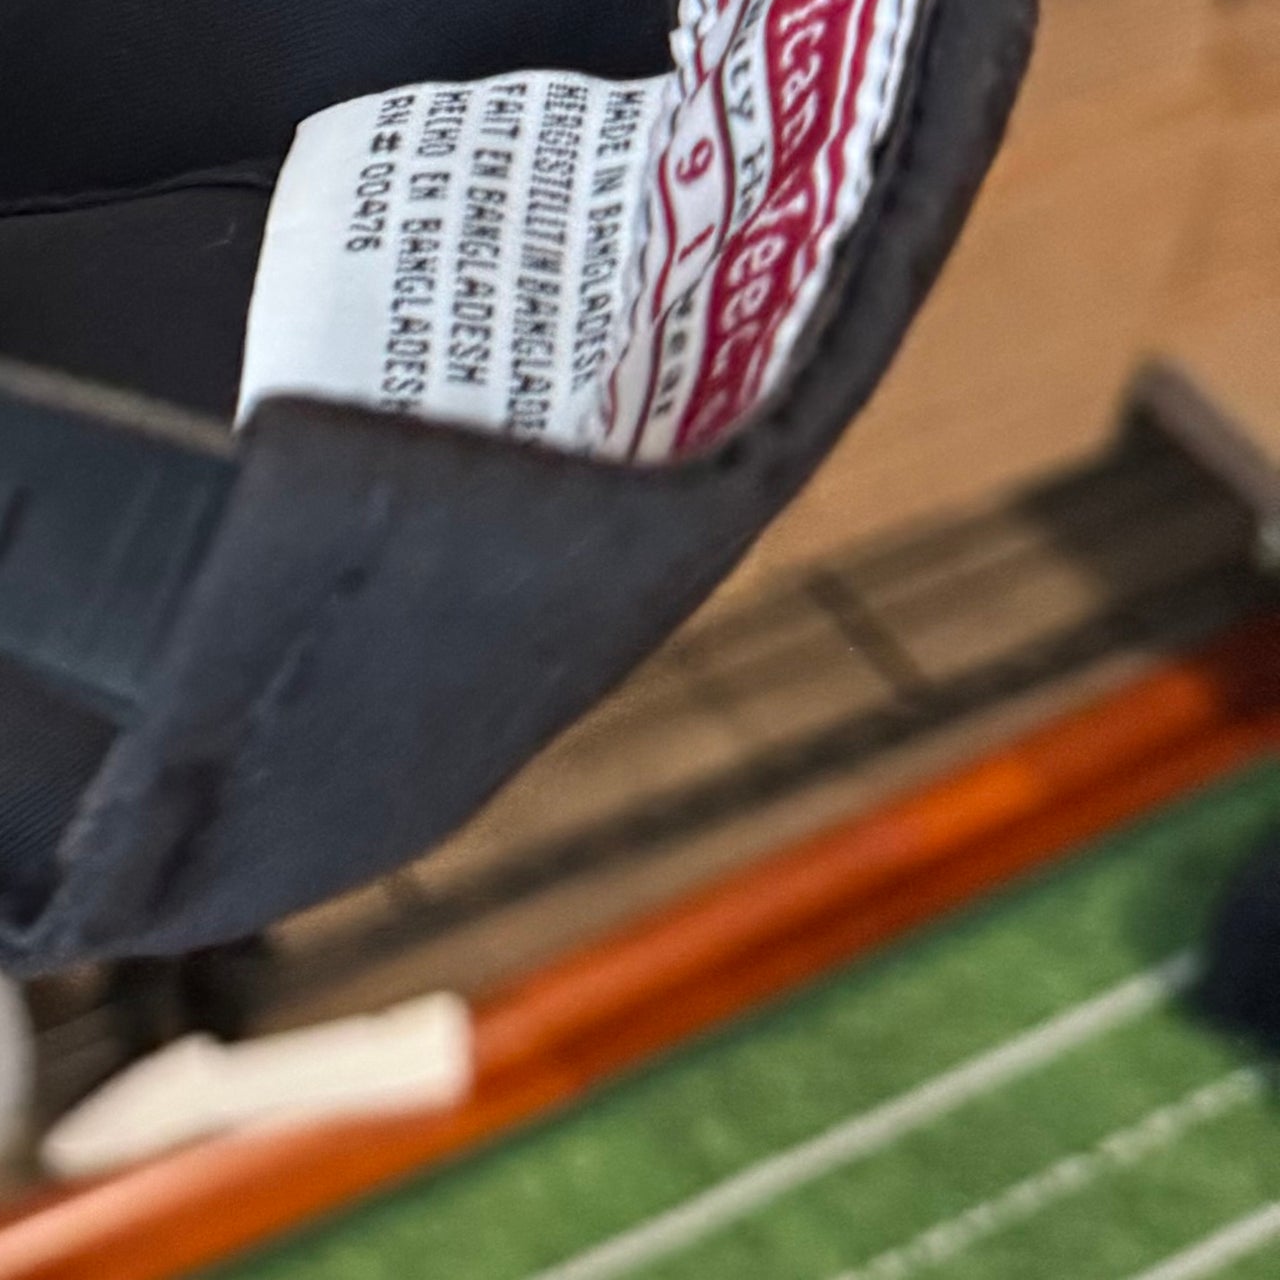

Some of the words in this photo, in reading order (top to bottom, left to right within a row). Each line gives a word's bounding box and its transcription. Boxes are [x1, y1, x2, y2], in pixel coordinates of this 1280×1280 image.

[416, 89, 474, 159] HECHO
[480, 82, 528, 140] FAIT
[596, 89, 645, 158] MADE
[408, 170, 451, 202] EN
[470, 147, 513, 180] EN
[525, 82, 589, 245] HERGESTELLT
[592, 163, 630, 197] IN
[344, 162, 396, 253] 00476
[445, 185, 508, 386] BANGLADESH
[520, 243, 564, 275] IN
